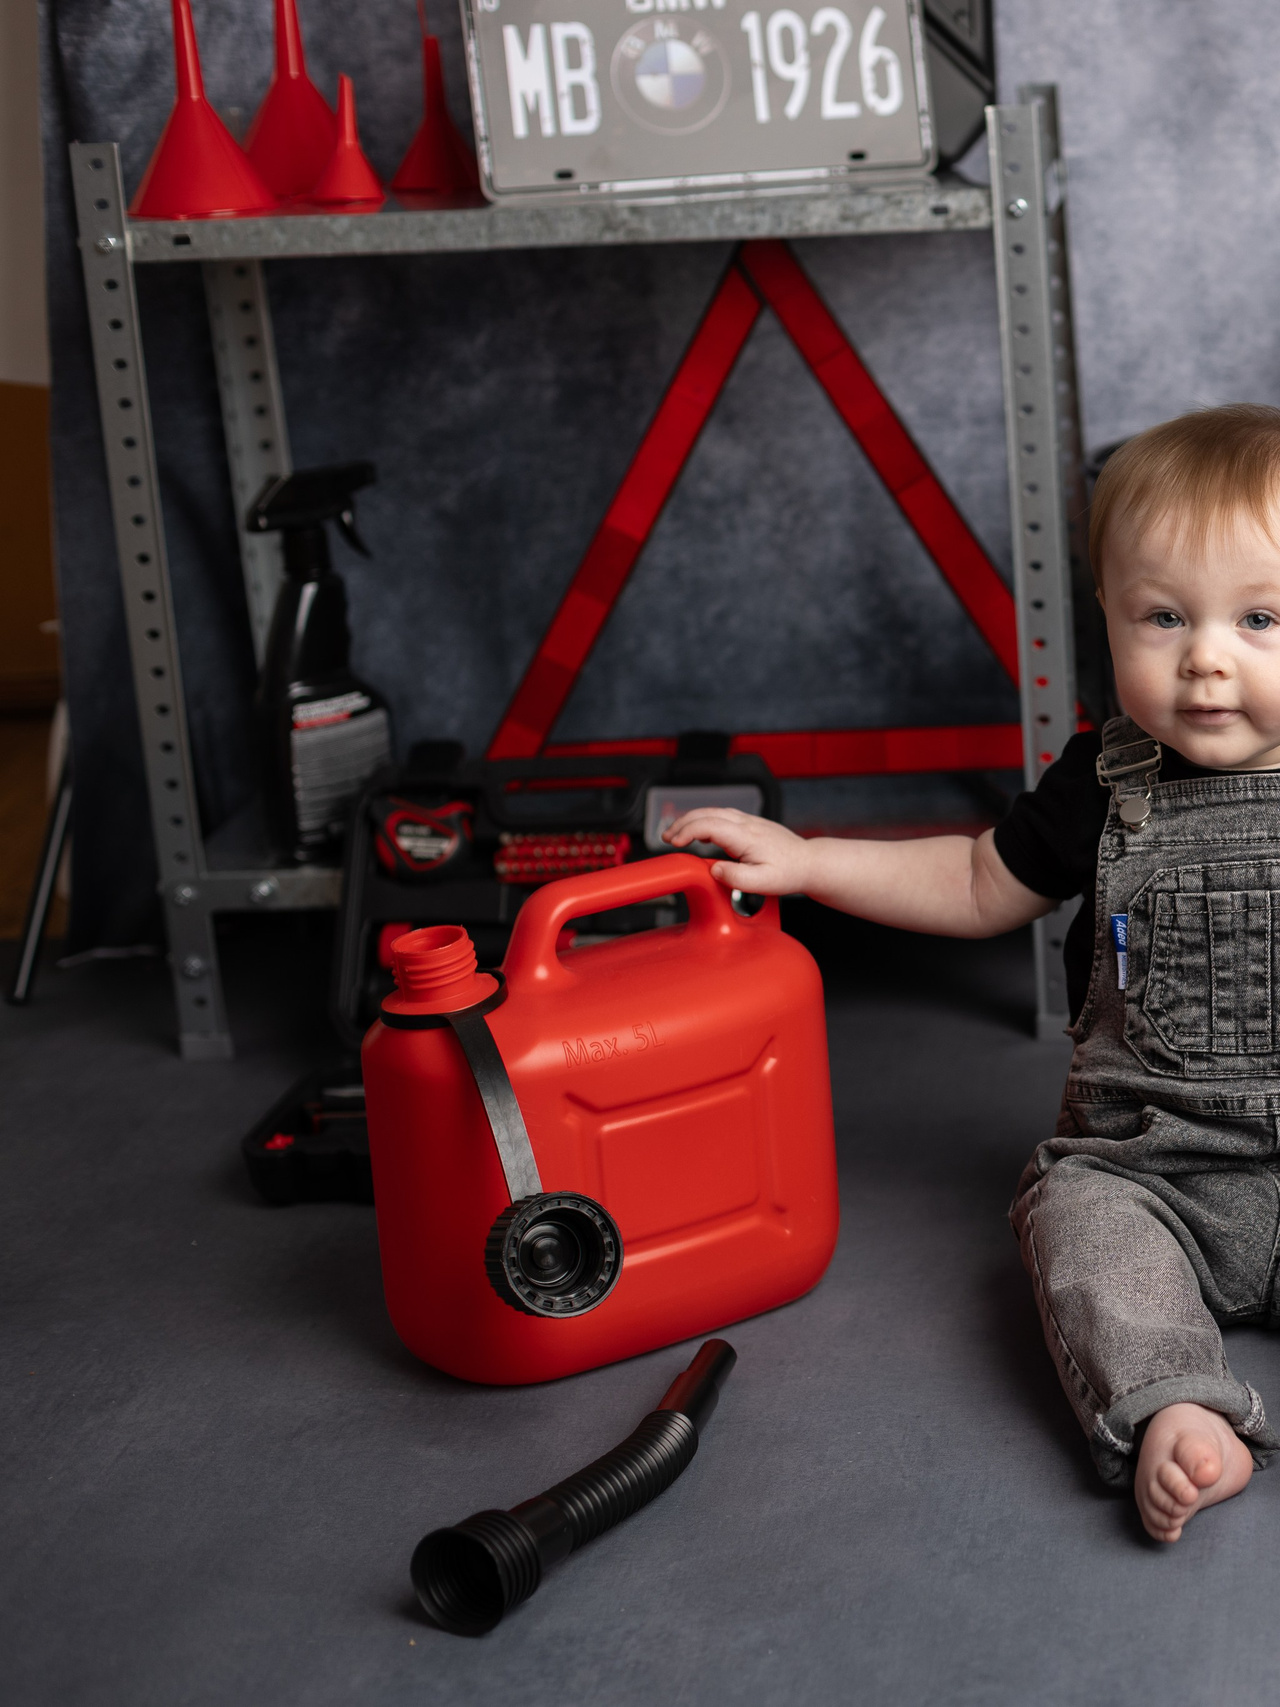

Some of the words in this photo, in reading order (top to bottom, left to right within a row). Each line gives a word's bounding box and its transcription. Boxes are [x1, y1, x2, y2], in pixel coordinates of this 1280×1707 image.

[502, 21, 601, 138] MB
[740, 6, 904, 123] 1926
[561, 1036, 629, 1069] Max.
[631, 1020, 666, 1053] 5L
